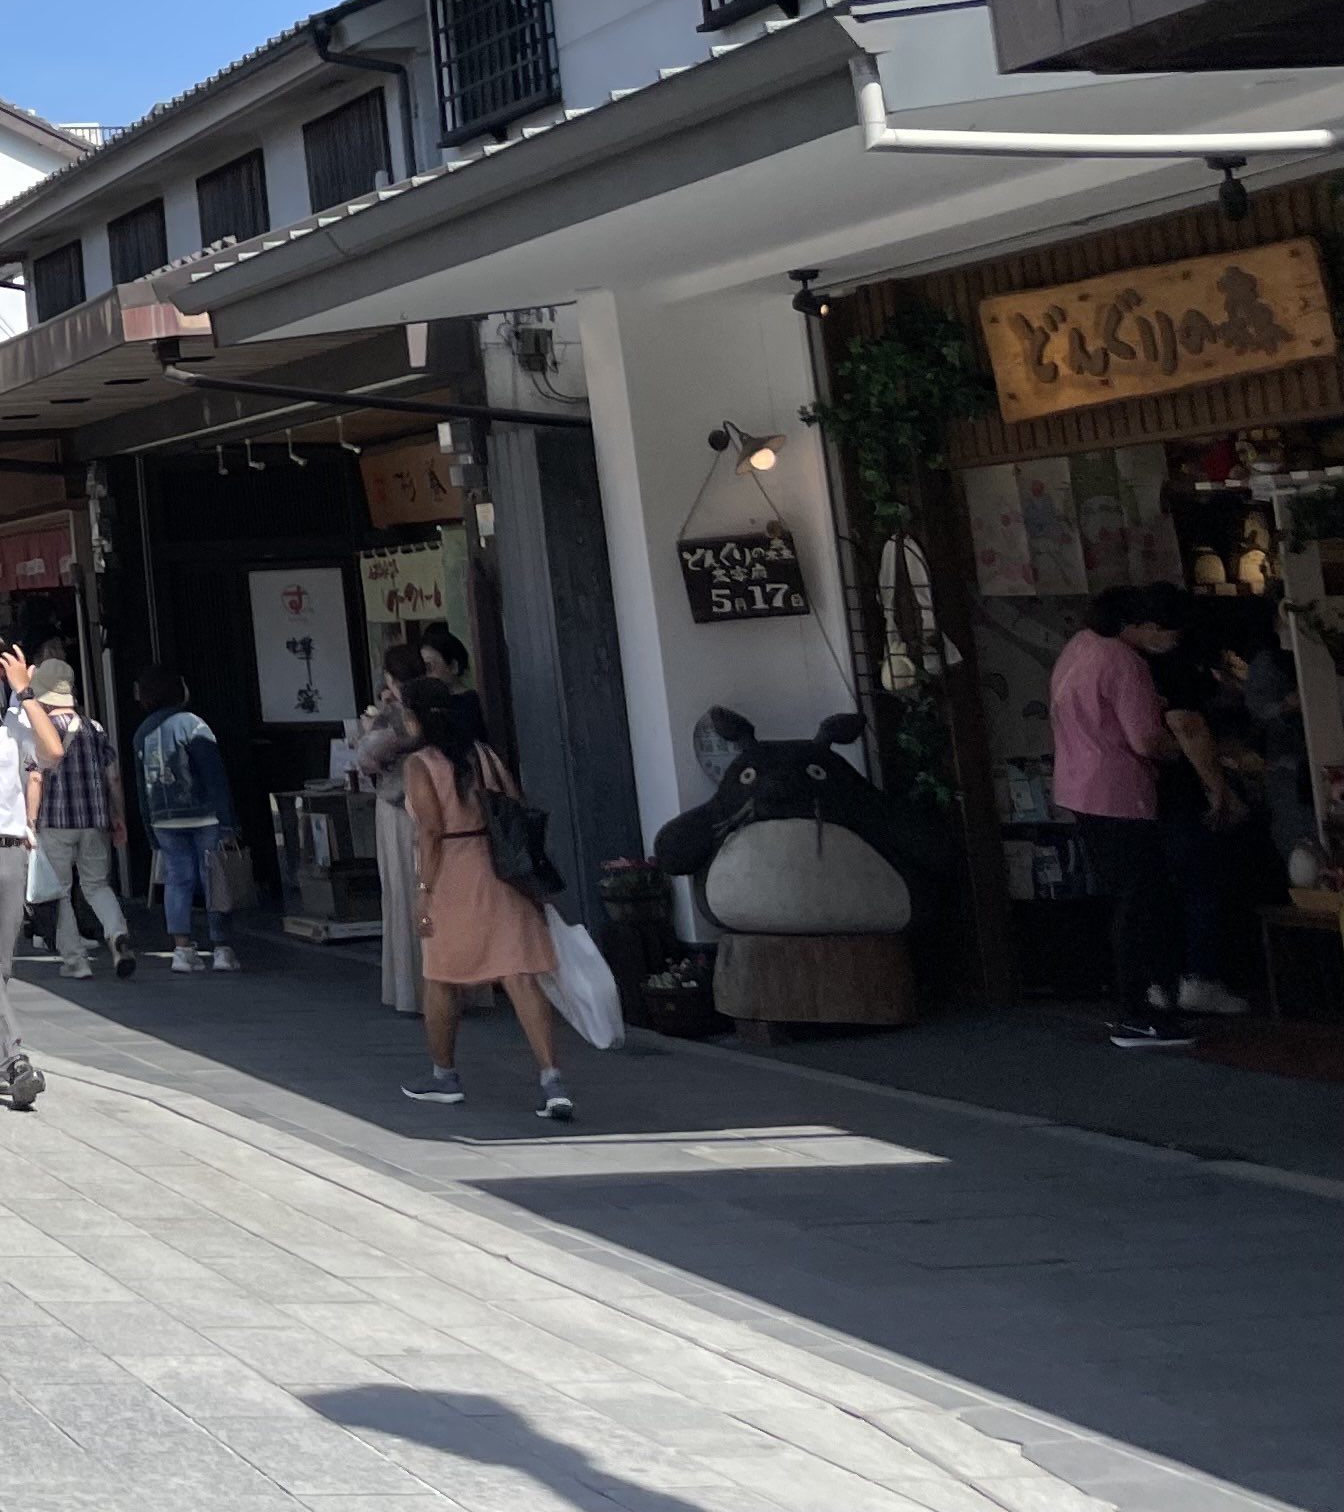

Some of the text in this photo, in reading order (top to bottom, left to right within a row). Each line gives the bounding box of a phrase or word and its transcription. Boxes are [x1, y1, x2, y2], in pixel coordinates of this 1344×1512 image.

[1010, 265, 1294, 384] どんぐりの森
